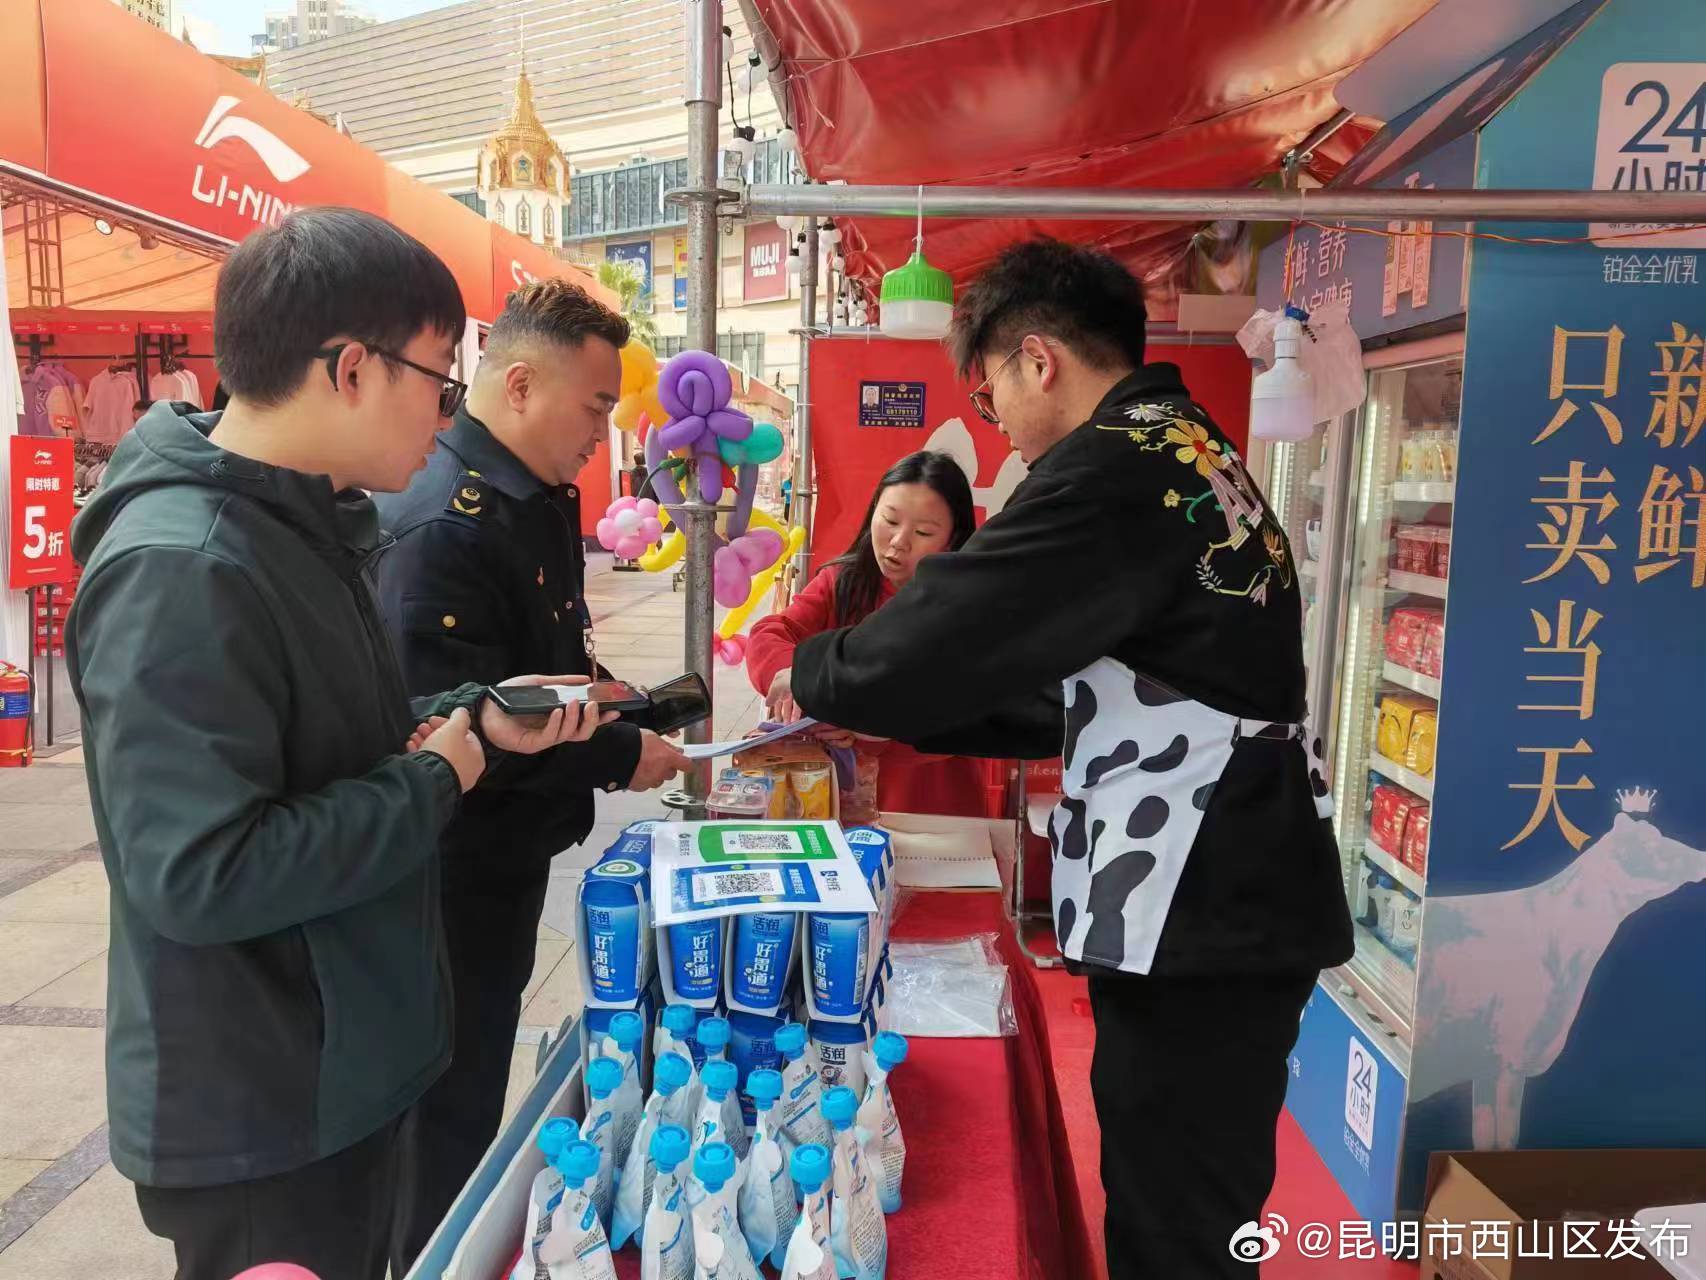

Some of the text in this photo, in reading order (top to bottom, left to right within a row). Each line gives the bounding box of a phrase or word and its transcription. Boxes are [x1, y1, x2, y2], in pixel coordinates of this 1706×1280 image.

[1617, 80, 1706, 153] 24
[192, 164, 304, 227] LI-NIN
[750, 242, 780, 267] MUJI
[1602, 254, 1699, 284] 铂金全优乳
[1499, 324, 1625, 852] 只卖当天
[820, 1045, 846, 1061] 活润
[1352, 1050, 1373, 1095] 24
[1350, 1086, 1371, 1124] 小时
